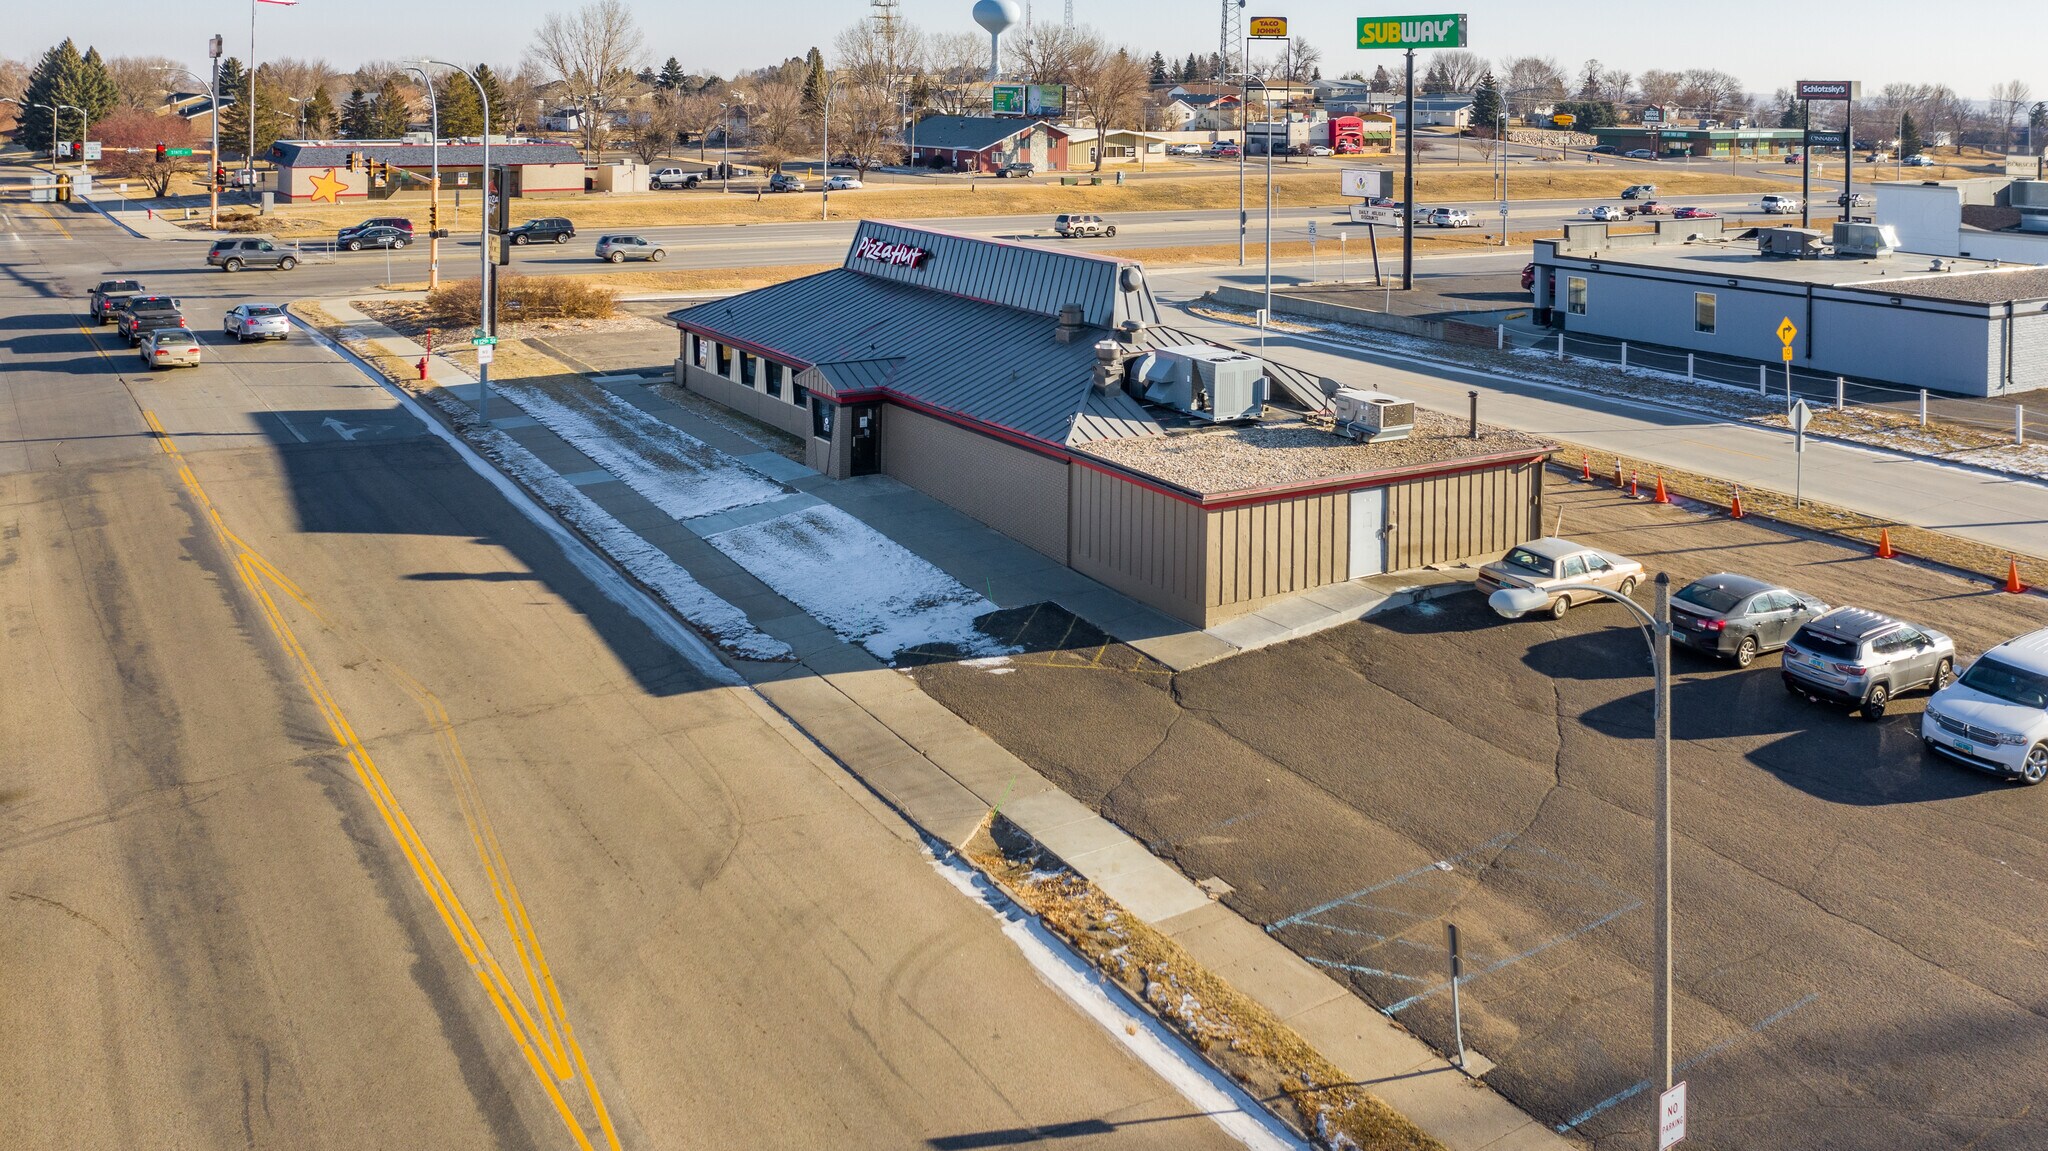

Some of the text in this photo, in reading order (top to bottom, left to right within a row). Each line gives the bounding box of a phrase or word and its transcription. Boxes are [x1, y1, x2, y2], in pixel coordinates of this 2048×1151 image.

[1360, 19, 1455, 45] SUBWAY
[1802, 85, 1845, 95] Schlotzsky's
[855, 236, 922, 268] Pizza Hut
[1667, 1102, 1679, 1117] NO
[1662, 1115, 1684, 1135] PARKING
